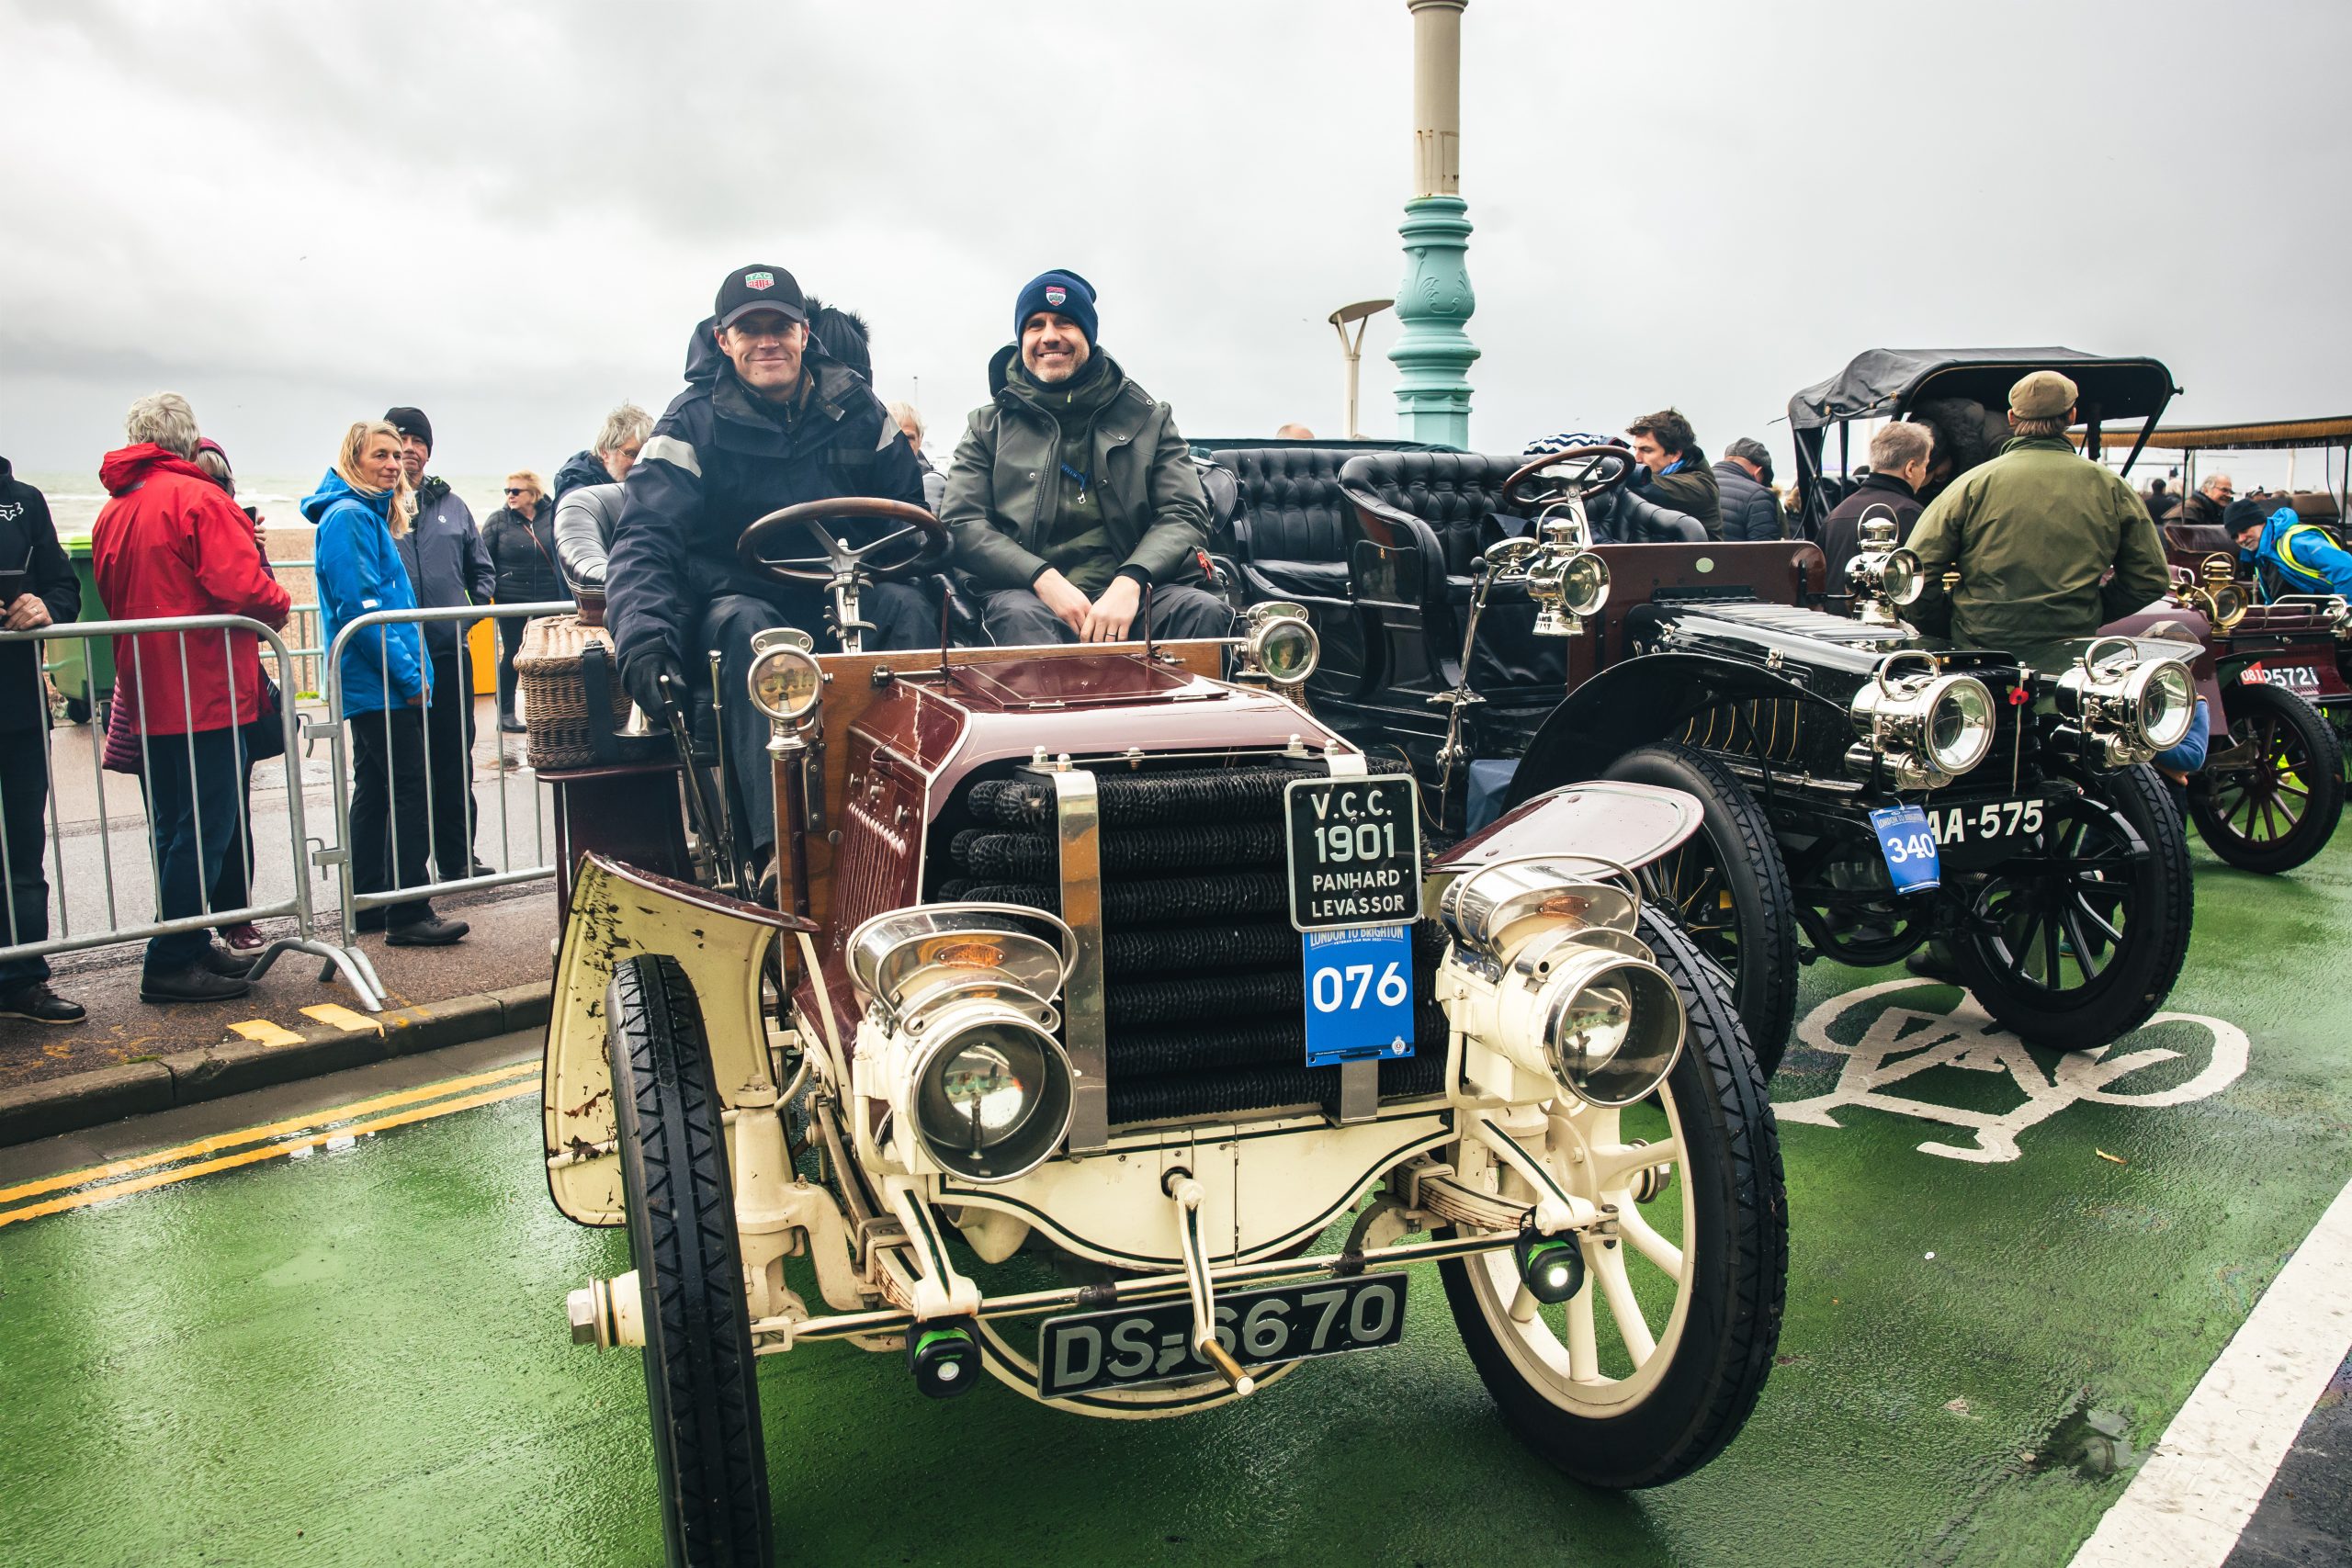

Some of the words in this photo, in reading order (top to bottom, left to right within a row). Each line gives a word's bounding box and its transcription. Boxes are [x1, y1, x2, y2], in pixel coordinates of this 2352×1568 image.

[746, 279, 775, 289] HEUER
[2241, 669, 2264, 682] 081
[1311, 790, 1392, 819] V.C.C.
[1928, 799, 2043, 845] AA-575
[1315, 823, 1395, 863] 1901
[1887, 833, 1936, 863] 340
[1312, 870, 1400, 892] PANHARD
[1312, 895, 1405, 918] LEVASSOR
[1312, 962, 1408, 1012] 076
